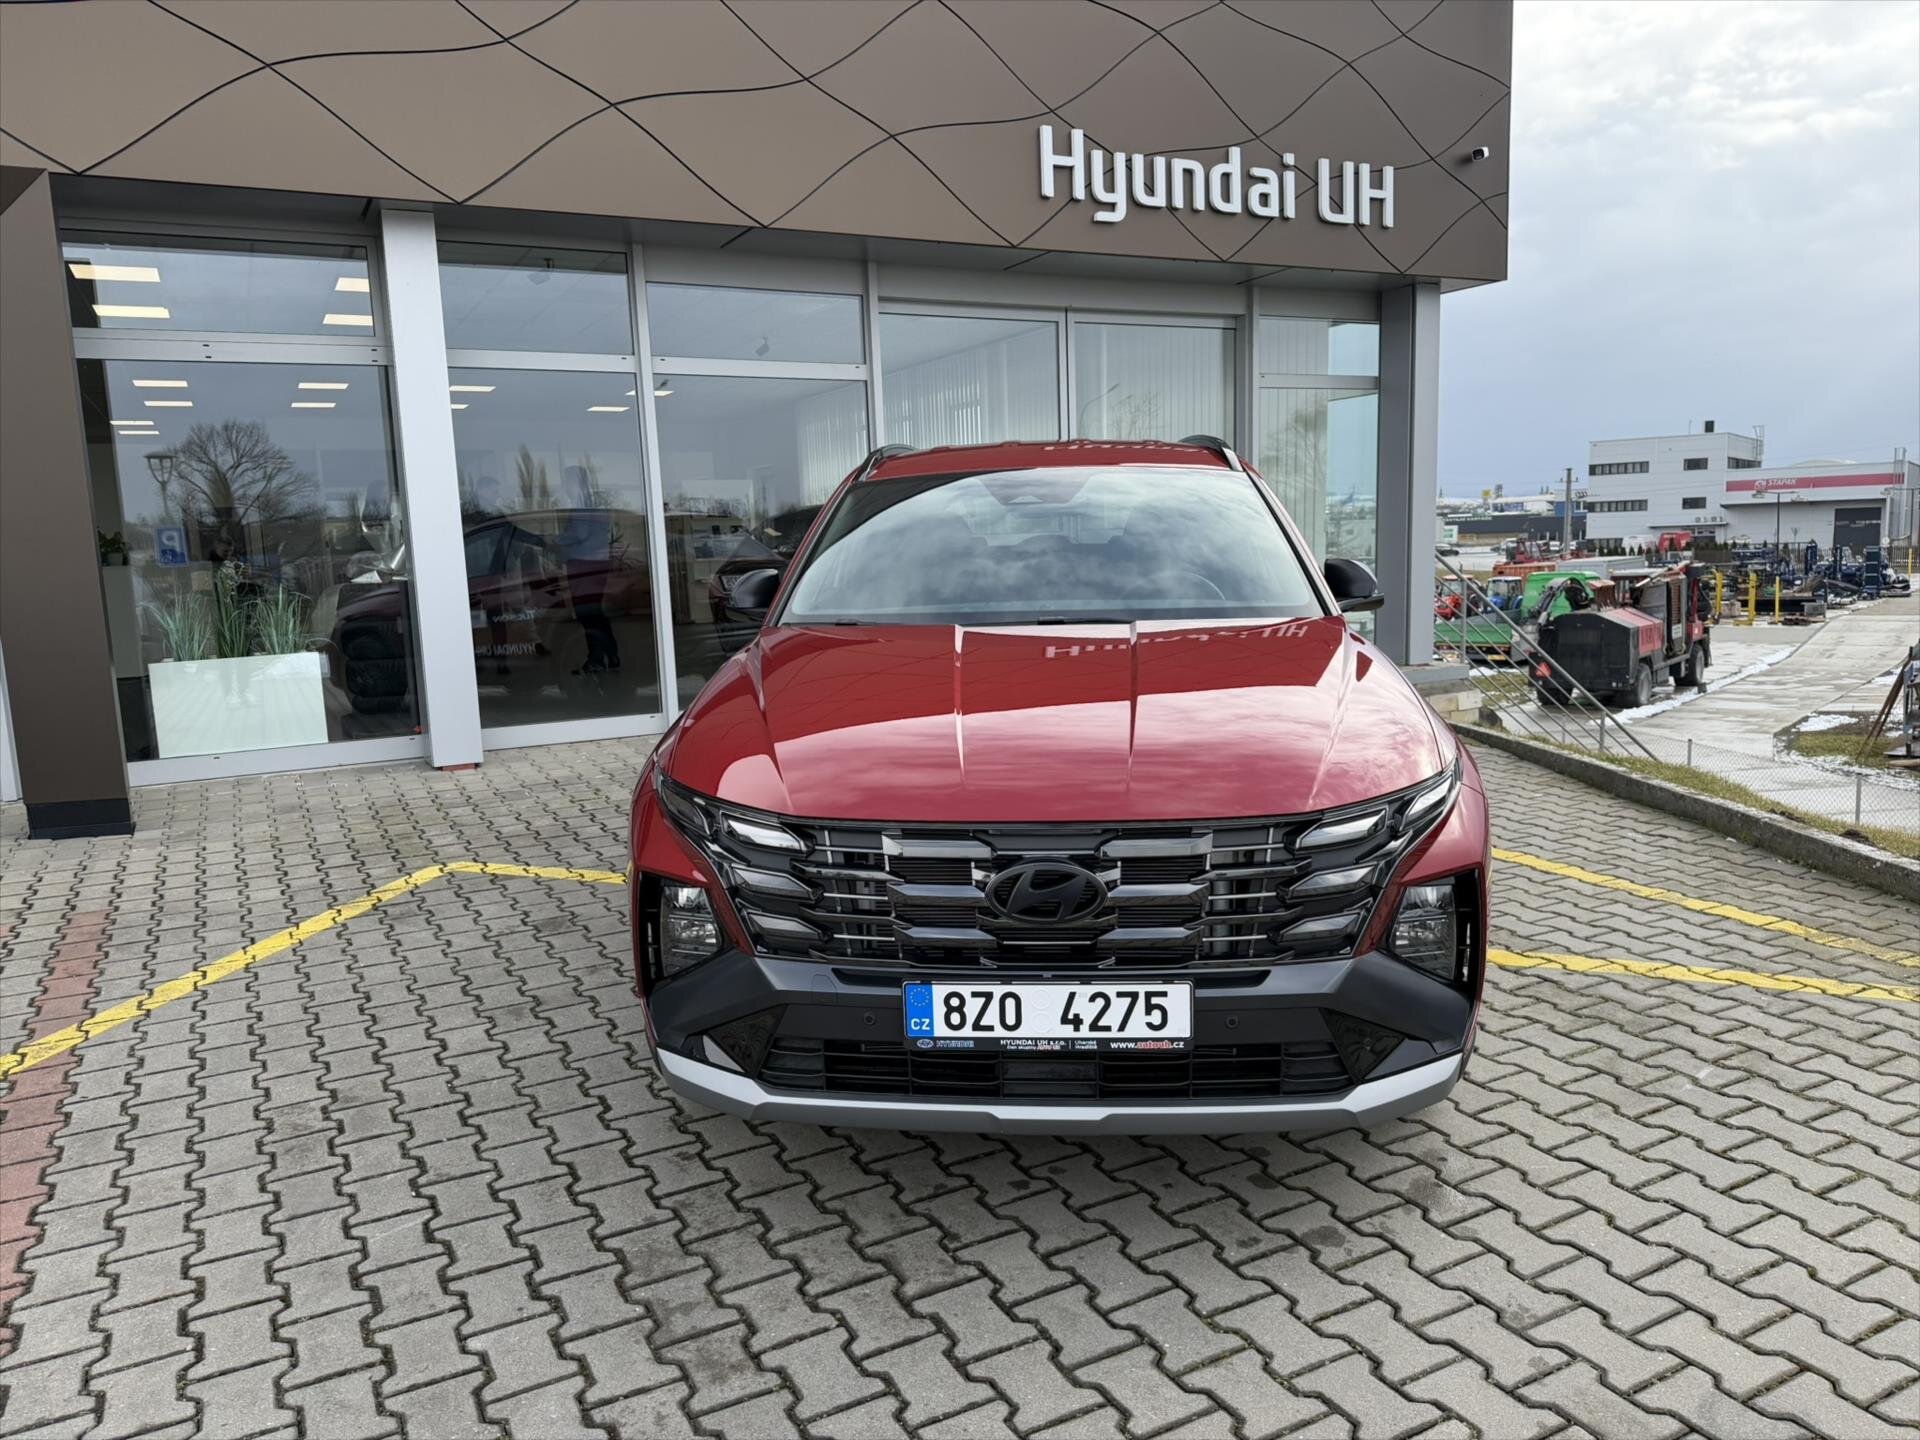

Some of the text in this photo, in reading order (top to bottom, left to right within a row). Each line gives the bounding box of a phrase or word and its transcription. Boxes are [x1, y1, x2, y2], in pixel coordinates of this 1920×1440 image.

[1039, 125, 1395, 229] Hyundai UH
[911, 1018, 931, 1031] CZ
[943, 991, 1169, 1032] 8Z0 4275
[1110, 1040, 1184, 1049] www.autouh.cz
